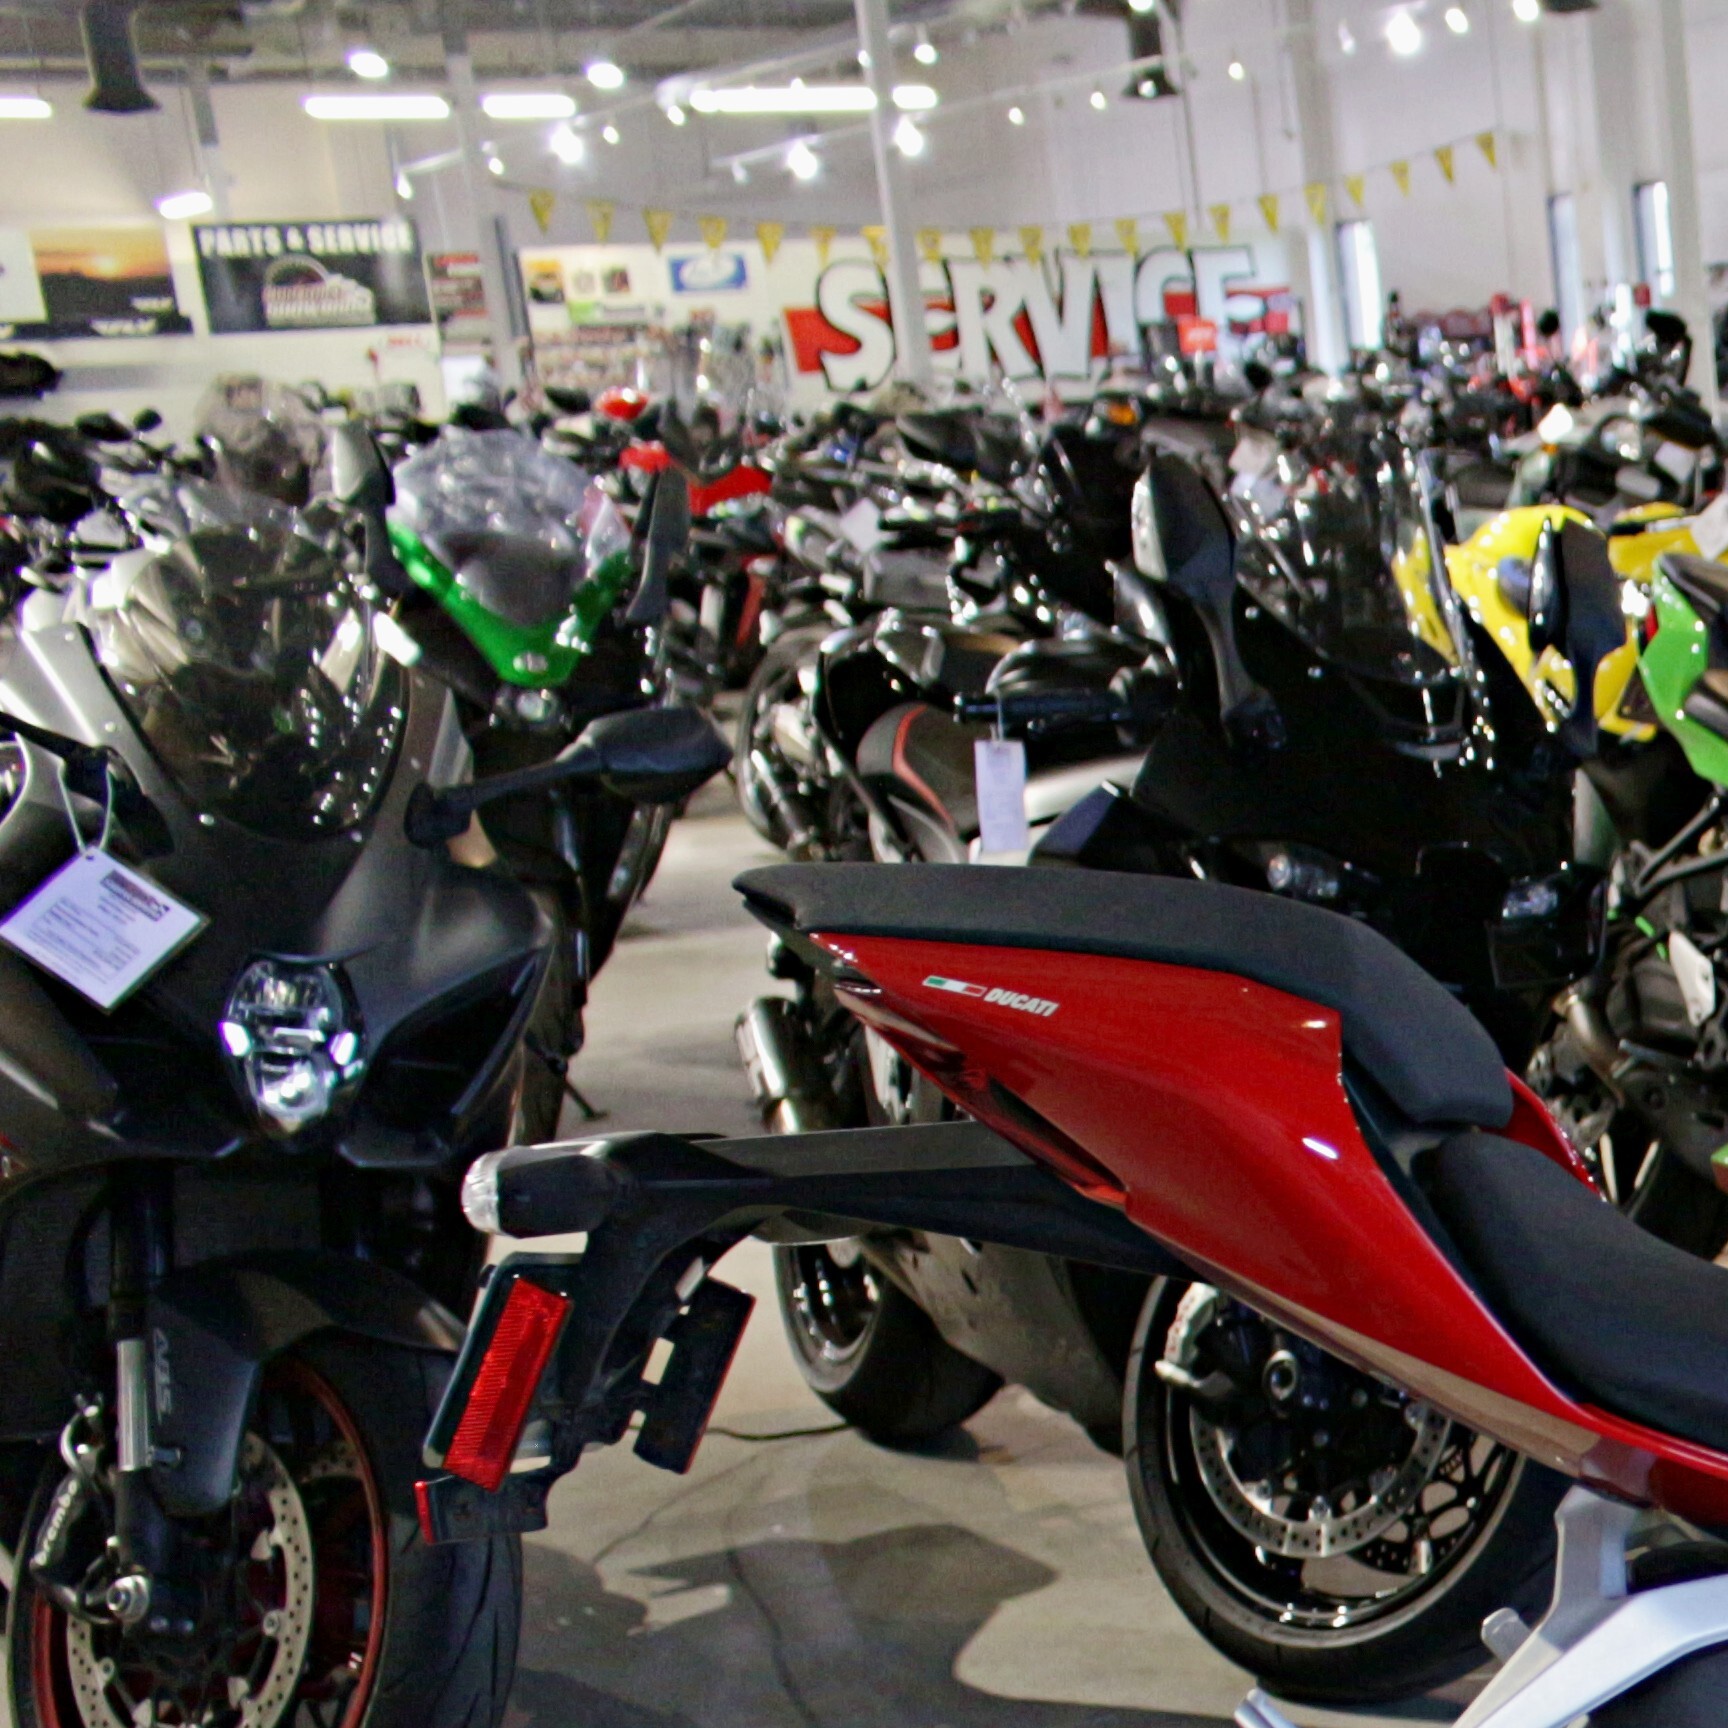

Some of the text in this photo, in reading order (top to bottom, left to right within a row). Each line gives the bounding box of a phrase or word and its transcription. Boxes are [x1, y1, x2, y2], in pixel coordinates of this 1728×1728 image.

[199, 226, 283, 258] PARTS
[983, 987, 1060, 1018] DUCATI
[31, 1477, 79, 1568] brembo
